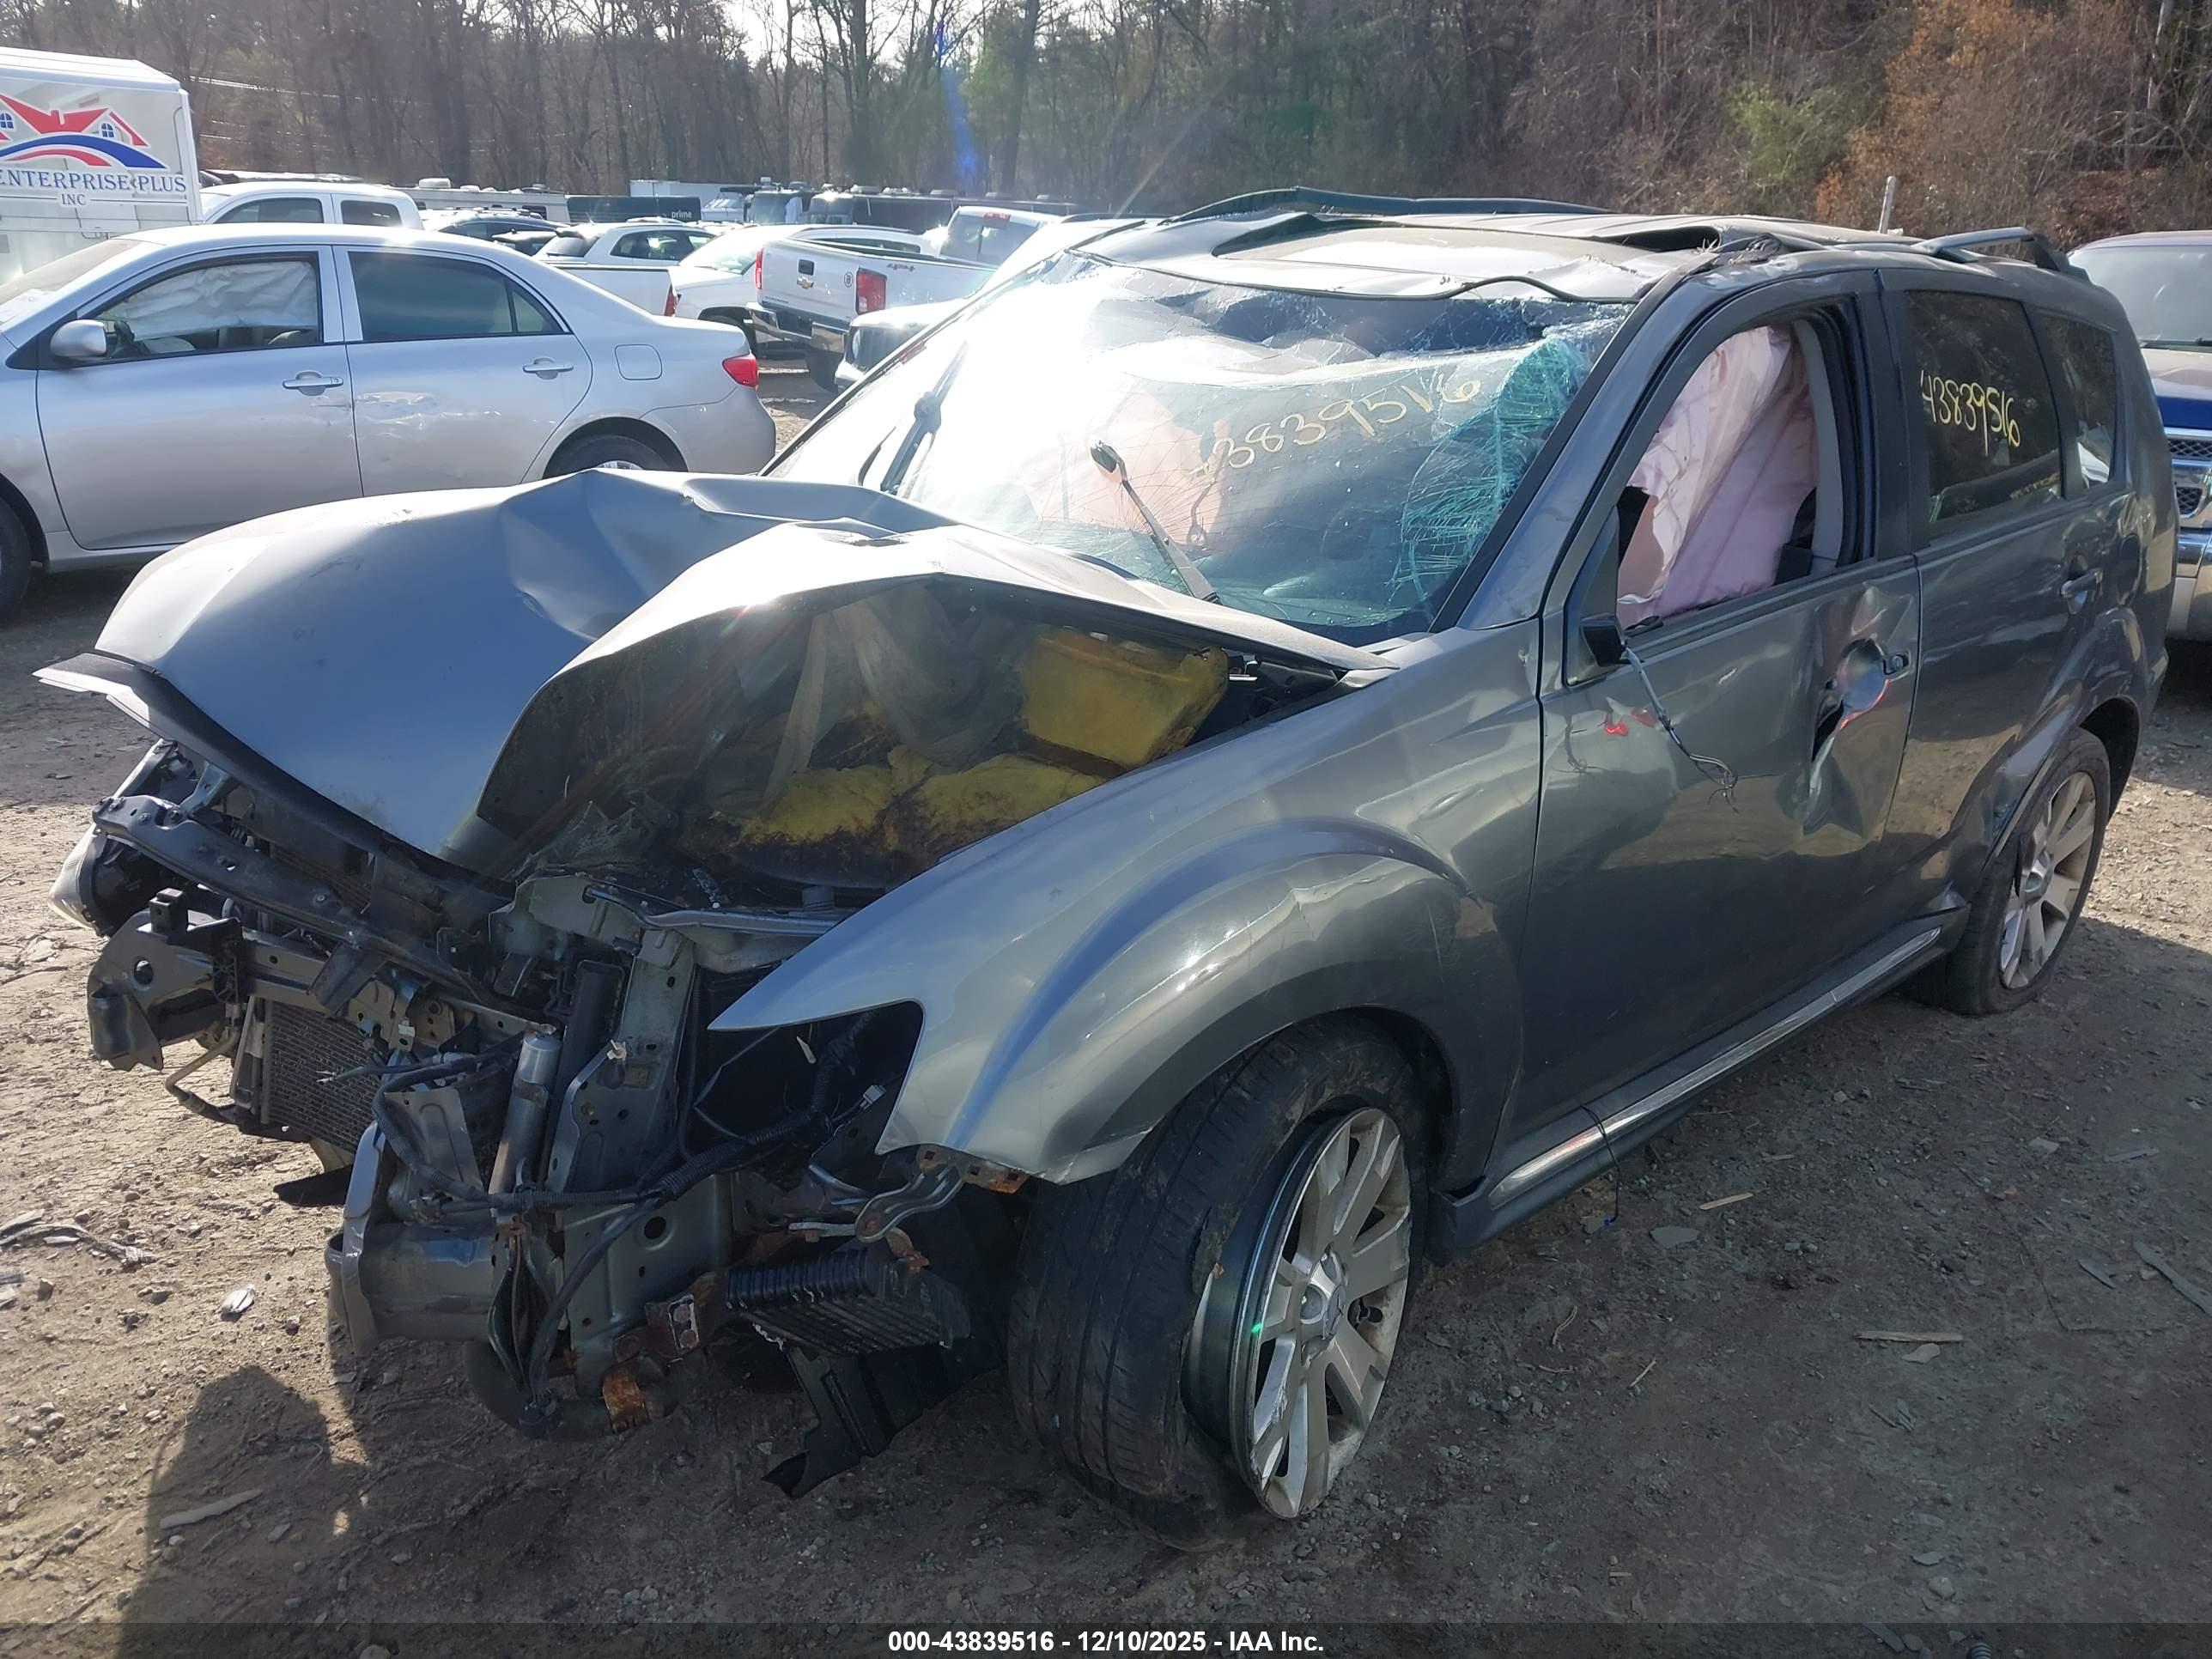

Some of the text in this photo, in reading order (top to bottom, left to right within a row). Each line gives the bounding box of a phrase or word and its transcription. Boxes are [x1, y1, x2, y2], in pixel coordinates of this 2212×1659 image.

[138, 175, 186, 192] PLUS
[61, 193, 86, 206] INC
[671, 209, 692, 219] prime
[1920, 369, 2021, 458] 43839516
